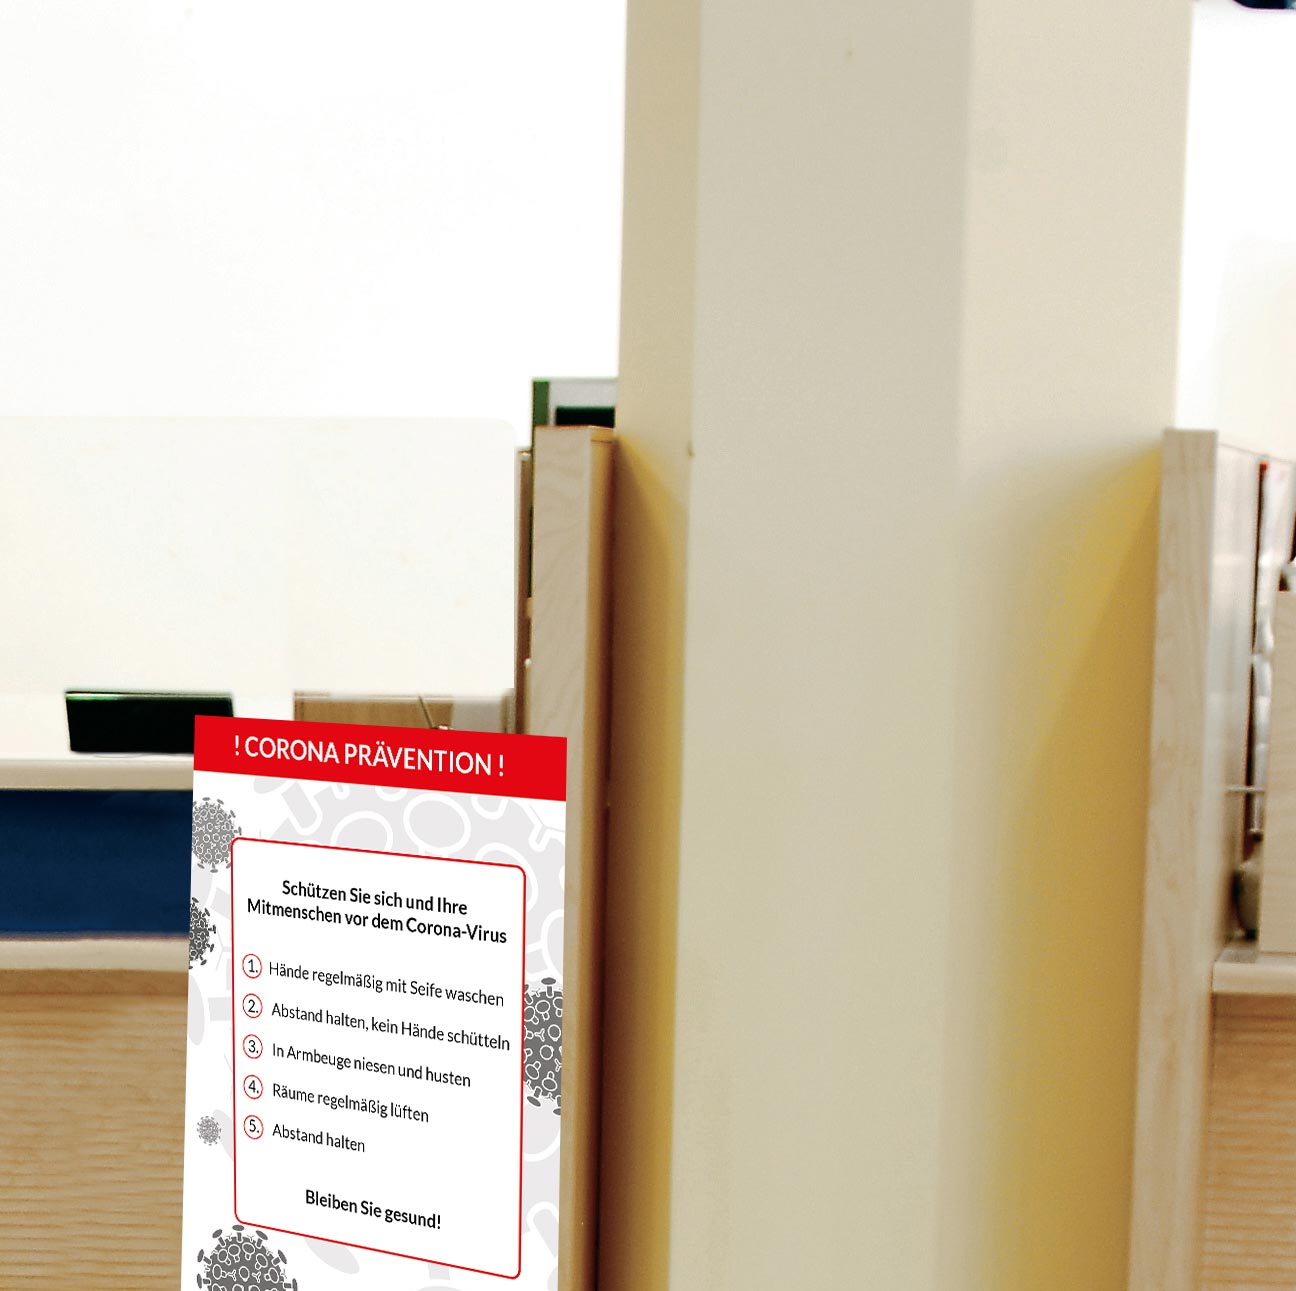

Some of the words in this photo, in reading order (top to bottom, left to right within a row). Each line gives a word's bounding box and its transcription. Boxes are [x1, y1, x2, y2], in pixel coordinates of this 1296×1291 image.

[235, 735, 240, 756] !
[244, 735, 340, 764] CORONA
[344, 740, 492, 776] PRÄVENTION
[499, 754, 504, 777] !
[282, 879, 347, 902] Schützen
[349, 887, 371, 904] Sie
[374, 890, 403, 908] sich
[405, 895, 434, 912] und
[437, 896, 468, 916] Ihre
[247, 897, 342, 924] Mitmenschen
[344, 913, 369, 927] vor
[371, 912, 404, 932] dem
[405, 917, 507, 944] Corona-Virus
[269, 961, 310, 981] Hände
[312, 970, 383, 994] regelmäßig
[386, 978, 407, 994] mit
[410, 980, 443, 999] Seife
[444, 988, 504, 1007] waschen
[271, 1002, 323, 1023] Abstand
[326, 1009, 369, 1032] halten,
[371, 1017, 398, 1035] kein
[401, 1021, 445, 1041] Hände
[447, 1029, 510, 1051] schütteln
[272, 1043, 284, 1058] In
[286, 1045, 352, 1071] Armbeuge
[353, 1056, 395, 1076] niesen
[398, 1065, 423, 1080] und
[425, 1066, 471, 1088] husten
[273, 1083, 315, 1104] Räume
[317, 1094, 388, 1119] regelmäßig
[390, 1102, 429, 1123] lüften
[272, 1123, 323, 1145] Abstand
[326, 1132, 365, 1153] halten
[305, 1189, 358, 1214] Bleiben
[360, 1200, 382, 1218] Sie
[384, 1208, 441, 1230] gesund!
